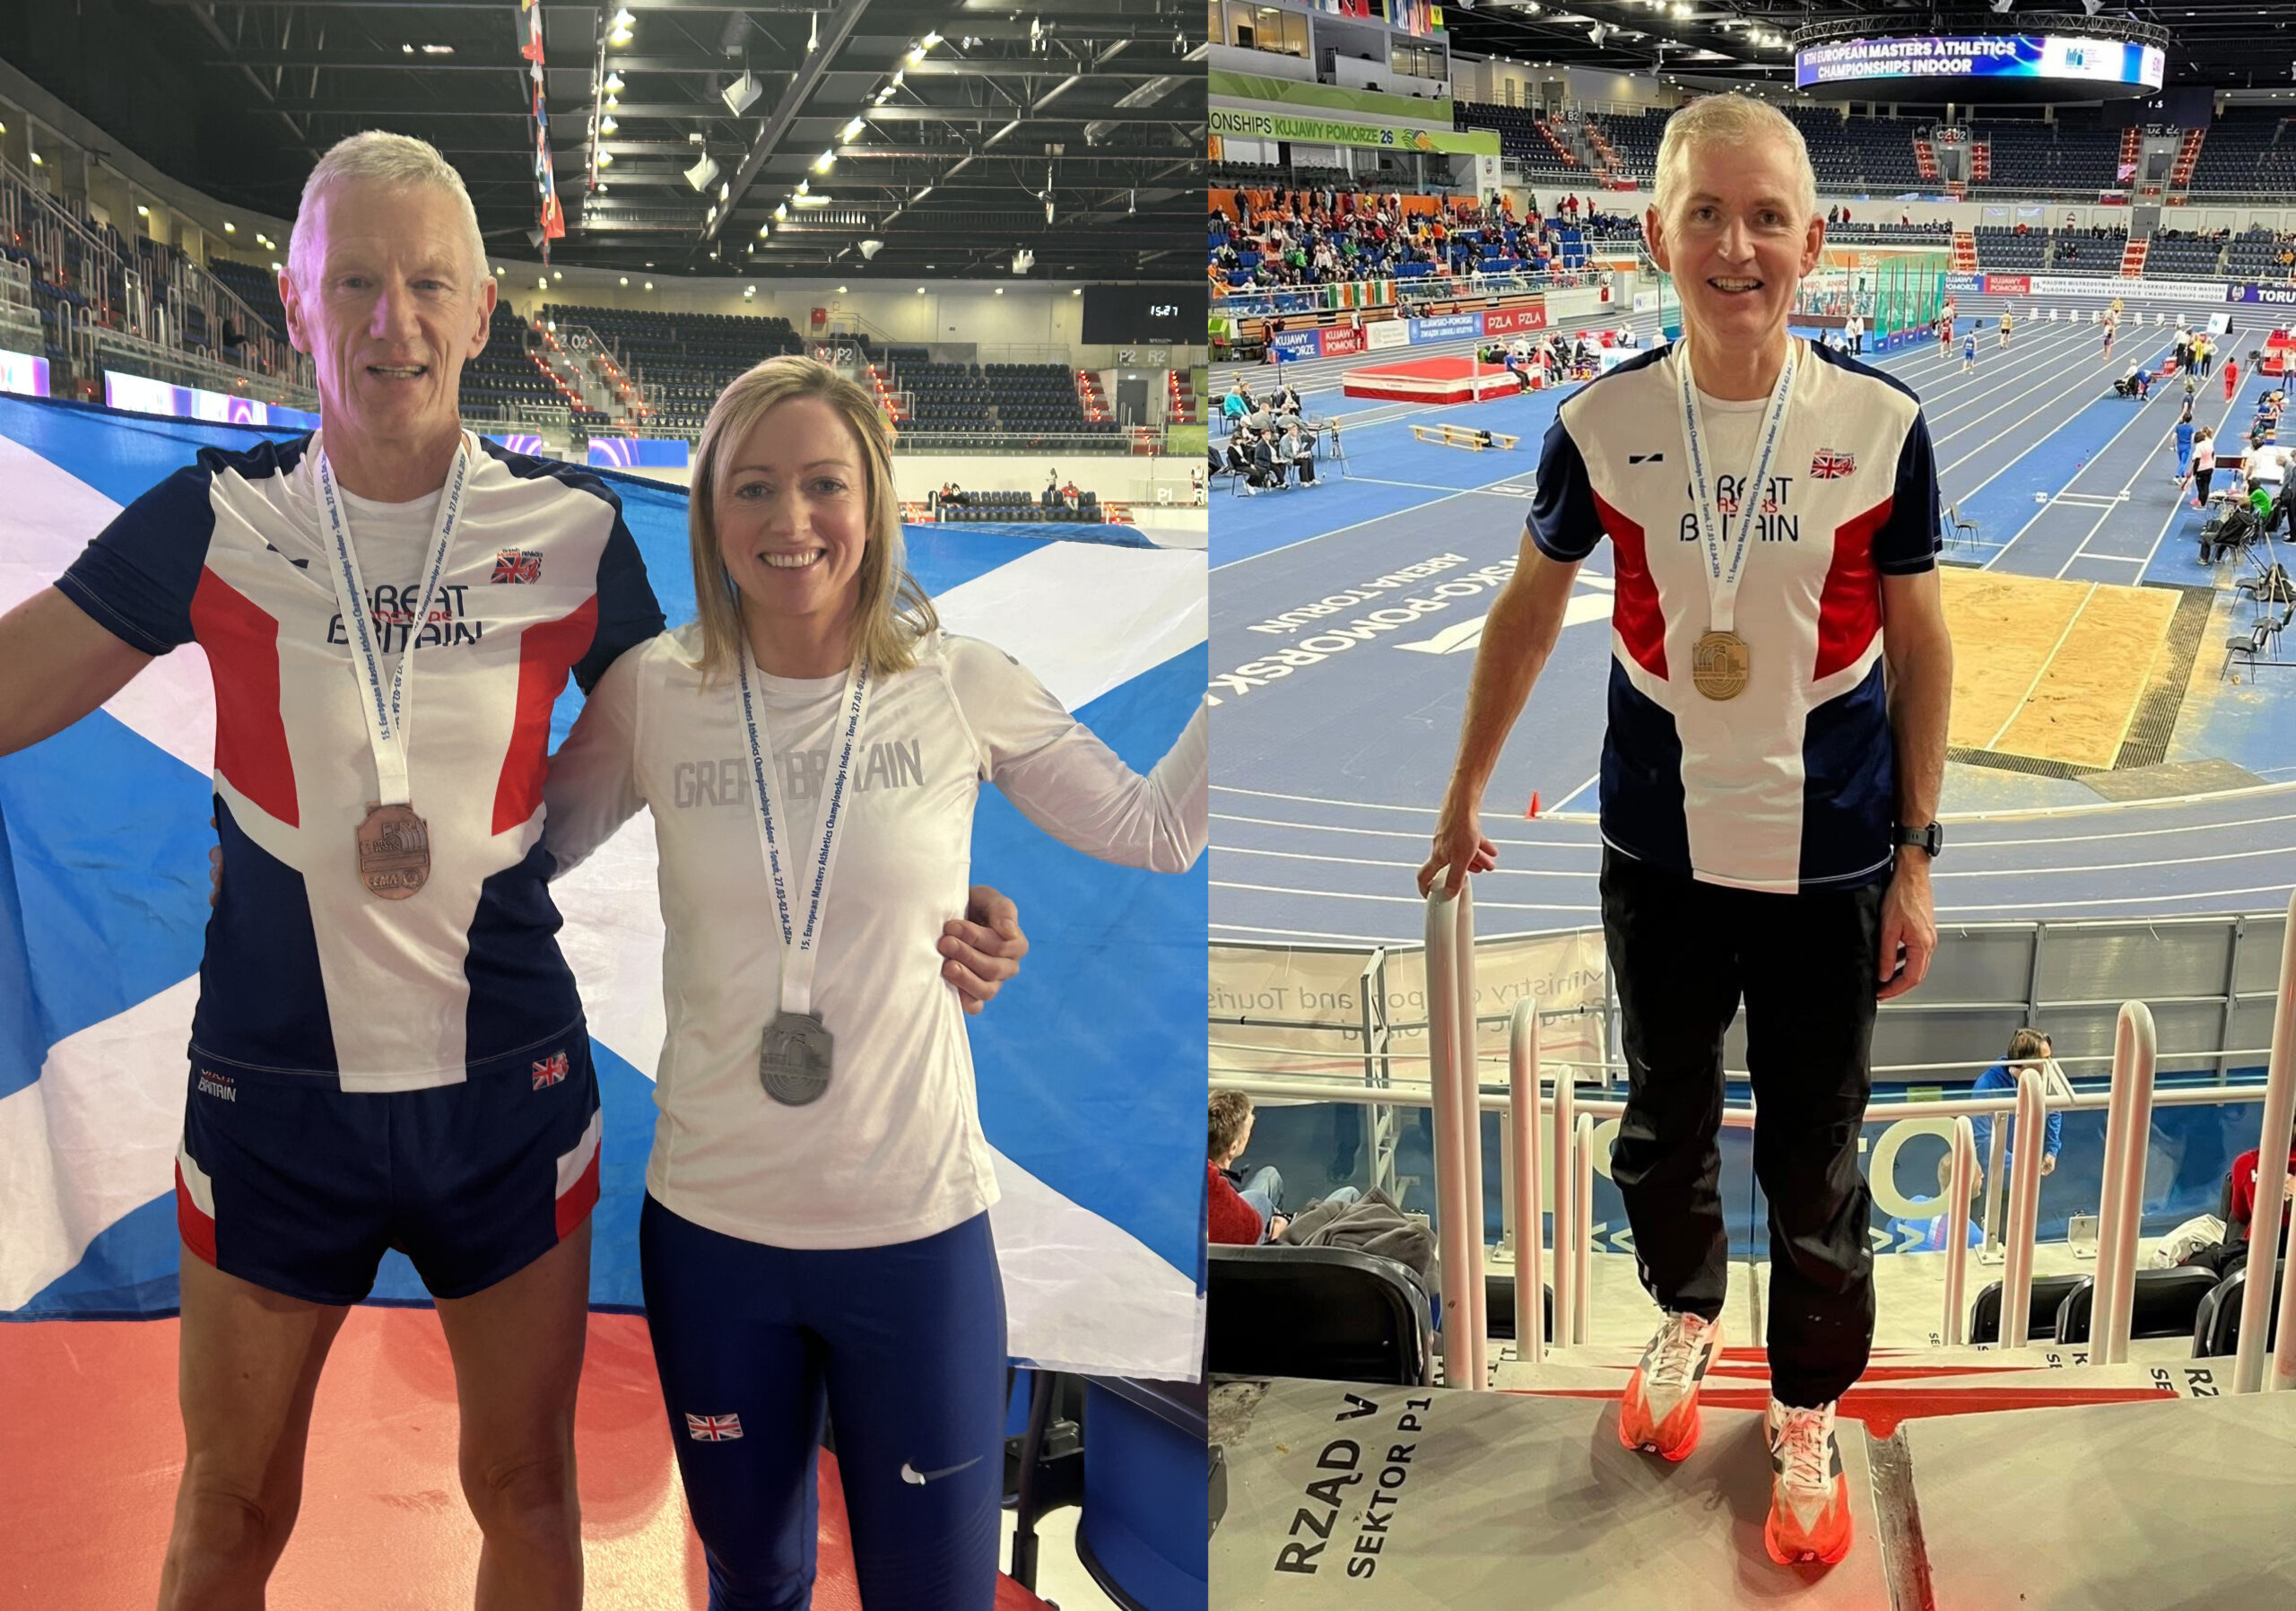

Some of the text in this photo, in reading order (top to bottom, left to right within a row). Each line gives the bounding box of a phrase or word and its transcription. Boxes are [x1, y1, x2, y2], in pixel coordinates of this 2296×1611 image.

[1817, 45, 1867, 64] EUROPEAN
[1868, 43, 1932, 57] MASTERS
[1933, 41, 2016, 56] ATHLETICS
[1818, 58, 1972, 79] CHAMPIONSHIPS INDOOR
[1568, 112, 1578, 120] B2
[1274, 118, 1324, 140] KUJAWY
[1326, 124, 1378, 144] POMORZE
[1380, 131, 1394, 144] 26
[2257, 290, 2296, 303] TORU
[1488, 312, 1541, 329] PZLA PZLA
[838, 348, 852, 361] P2
[1275, 334, 1308, 346] KUJAWY
[1326, 340, 1356, 353] POMOR
[1119, 350, 1166, 362] P2 R2
[1688, 475, 1793, 504] RAT
[1680, 513, 1799, 542] BIAIN
[1729, 544, 1743, 573] European
[1738, 518, 1750, 544] Masters
[418, 568, 439, 621] Championships
[433, 538, 447, 564] Indoor
[1246, 553, 1469, 634] ARENA TORUŃ
[335, 584, 469, 618] REAT
[371, 610, 453, 623] ASTRS
[1208, 555, 1519, 707] SKO-POMORSK
[743, 692, 754, 721] Masters
[748, 721, 760, 756] Athletics
[785, 739, 925, 801] BRAIN
[754, 757, 770, 817] Championships
[764, 817, 775, 845] Indoor
[804, 898, 818, 937] European
[812, 866, 825, 898] Masters
[819, 831, 833, 866] Athletics
[826, 770, 847, 829] Championships
[840, 743, 853, 770] Indoor
[197, 1076, 237, 1103] BRITAIN
[1274, 1393, 1378, 1574] RZĄD V
[1346, 1398, 1431, 1579] SEKTOR P1
